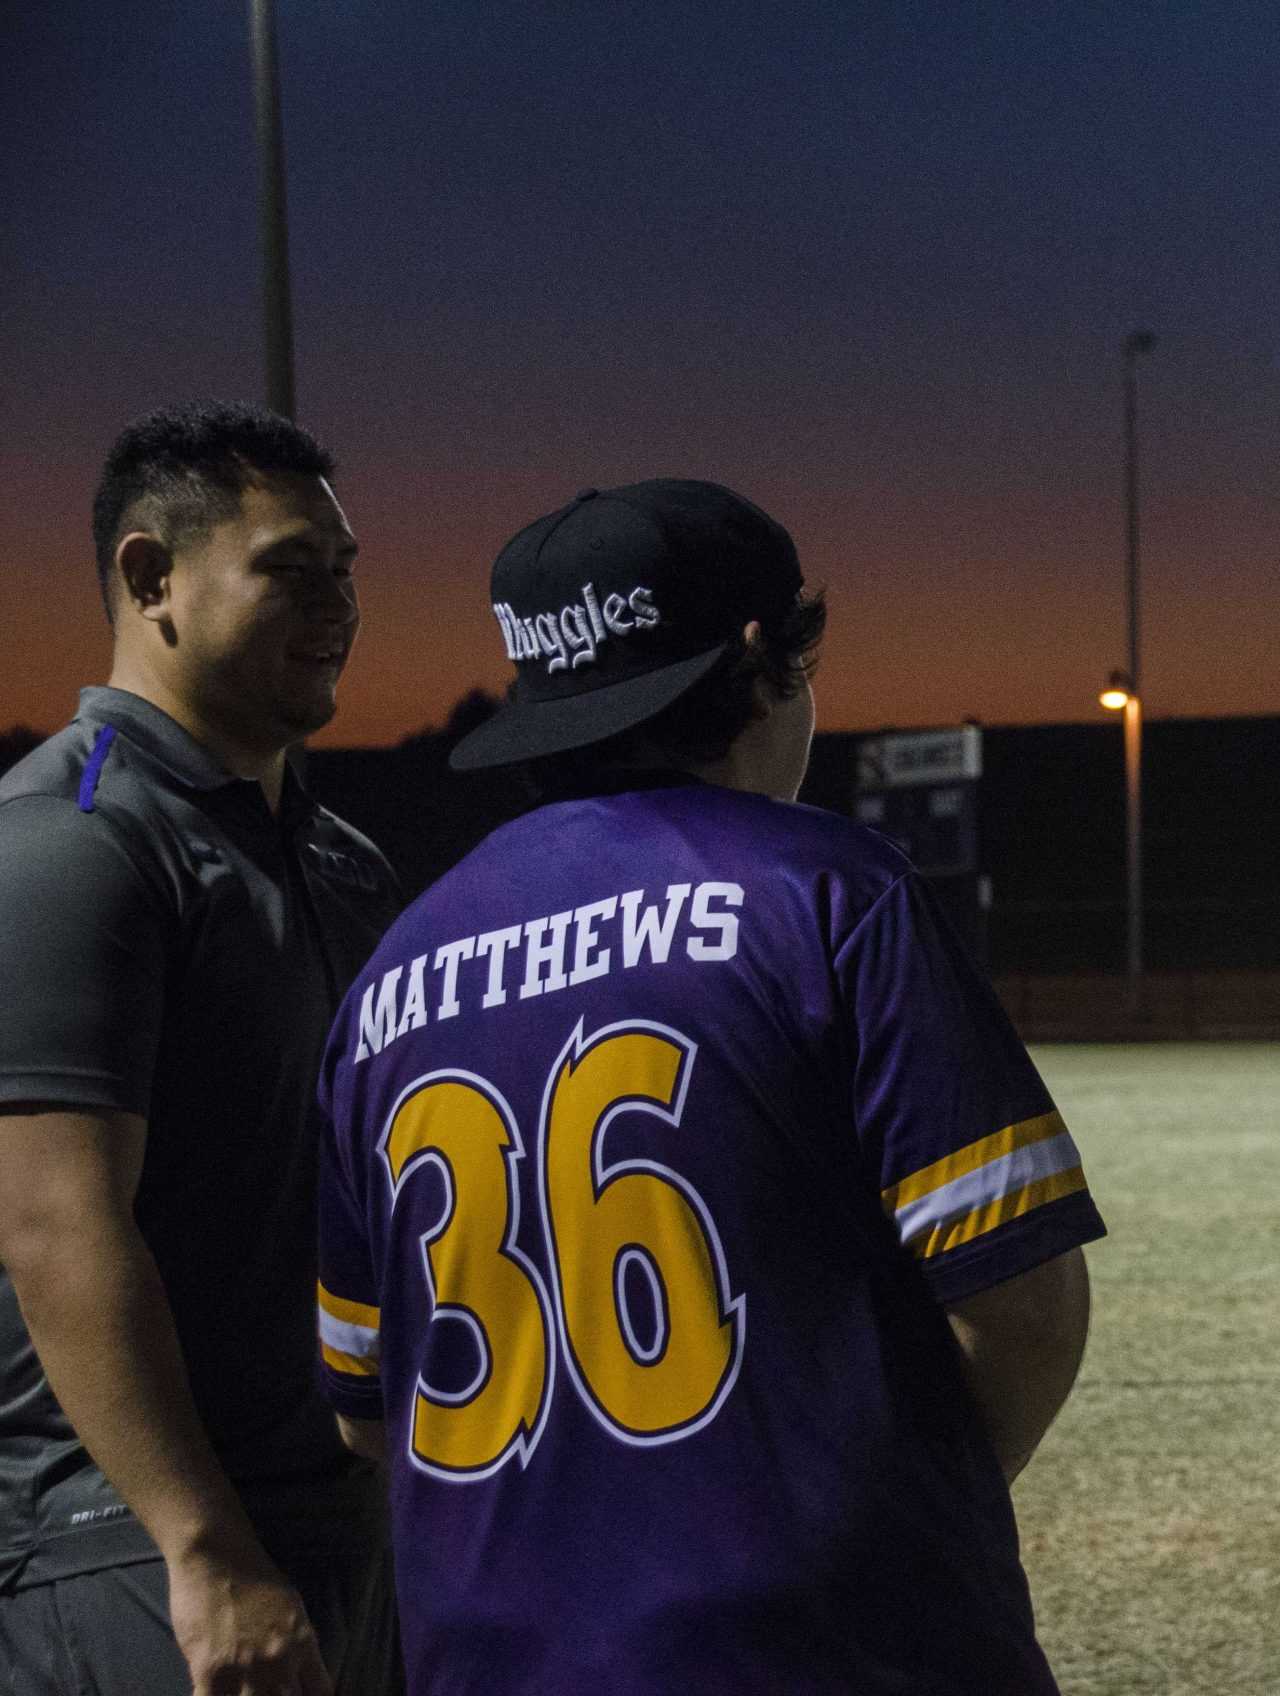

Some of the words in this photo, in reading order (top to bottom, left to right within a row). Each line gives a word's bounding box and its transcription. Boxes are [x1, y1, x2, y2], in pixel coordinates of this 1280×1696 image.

[493, 581, 661, 675] Muggles
[354, 882, 746, 1064] MATTHEWS
[376, 1014, 747, 1482] 36
[71, 1504, 130, 1525] DRI-FIT
